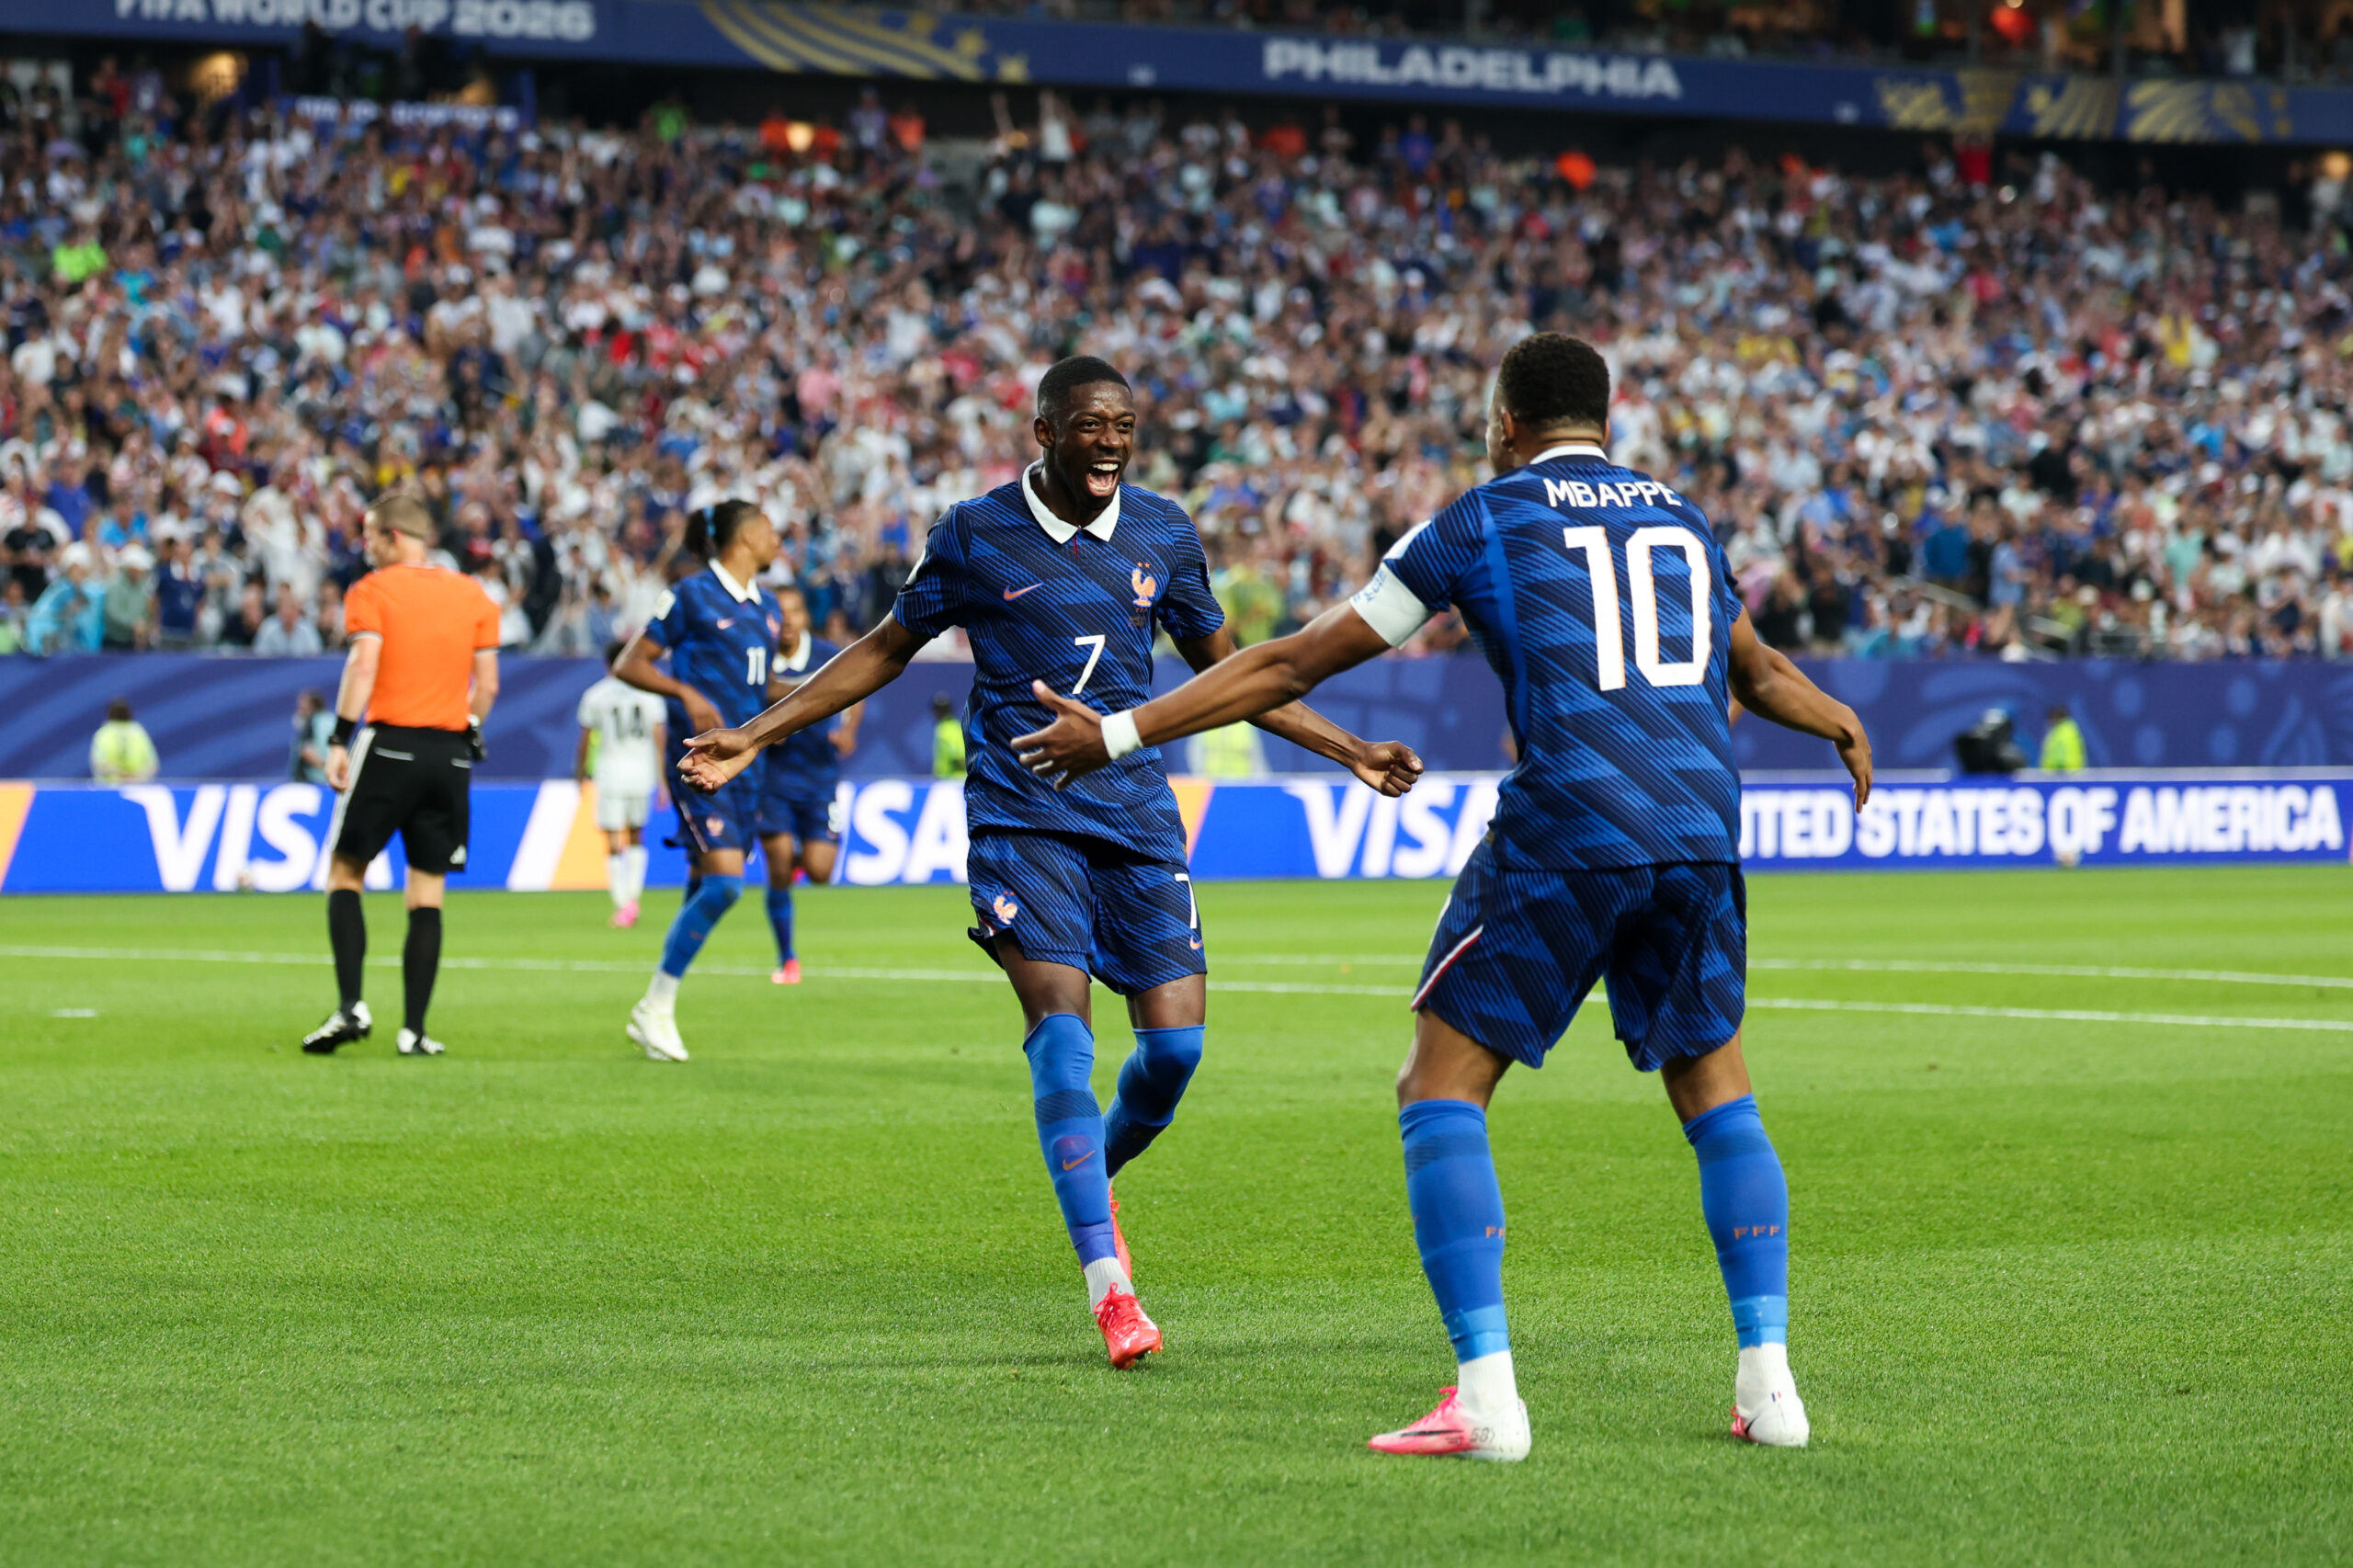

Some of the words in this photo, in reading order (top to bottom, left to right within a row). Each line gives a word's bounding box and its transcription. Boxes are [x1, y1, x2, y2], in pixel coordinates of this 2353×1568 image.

[450, 0, 596, 41] 2026
[1263, 39, 1682, 99] PHILADELPHIA
[1563, 526, 1711, 691] 10
[746, 646, 767, 686] 11
[1072, 634, 1106, 695] 7
[611, 705, 642, 739] 14
[1739, 789, 1854, 858] ITED
[1855, 788, 2045, 857] STATES
[2047, 786, 2118, 855] OF
[2119, 784, 2344, 853] AMERICA
[1175, 873, 1198, 929] 7
